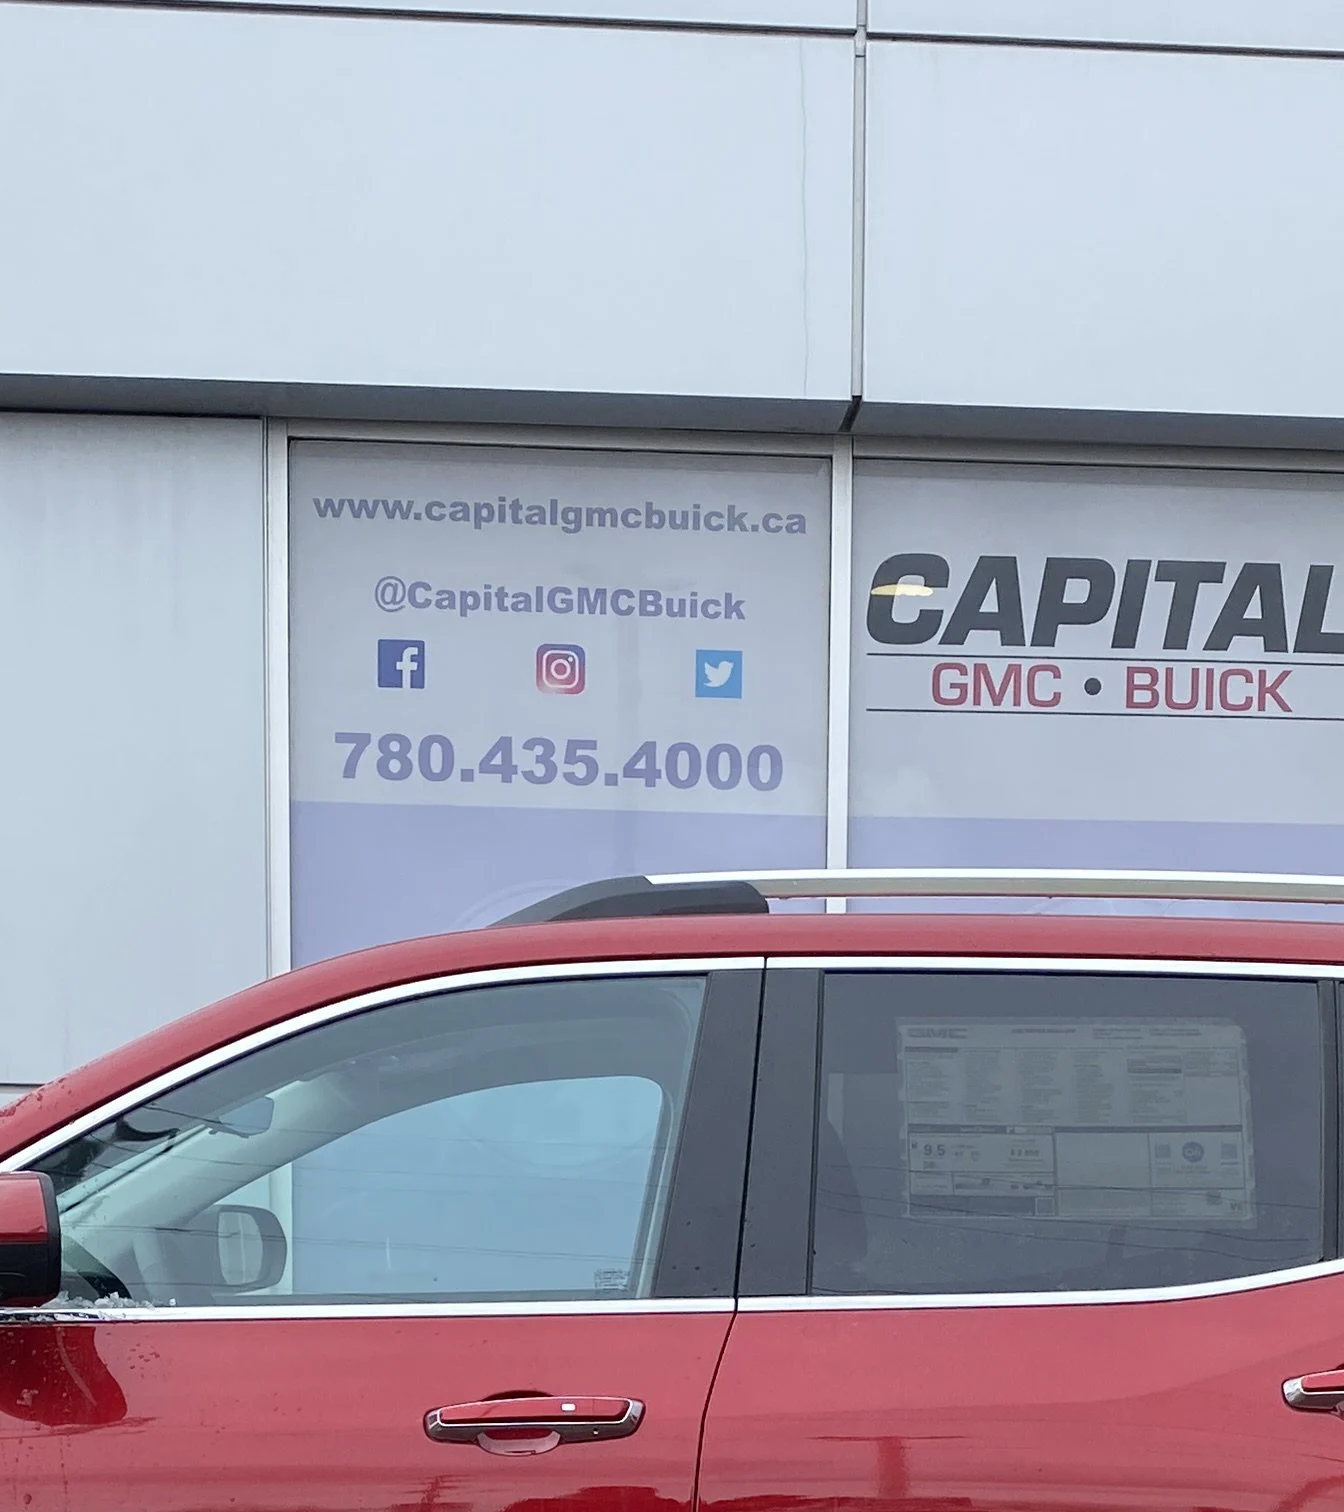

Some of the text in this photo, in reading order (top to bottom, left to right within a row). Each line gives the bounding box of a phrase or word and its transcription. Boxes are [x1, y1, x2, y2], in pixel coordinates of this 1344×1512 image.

[312, 495, 807, 535] www.capitalgmcbuick.ca
[374, 575, 746, 621] @CapitalGMCBuick
[931, 662, 1294, 713] GMC BUICK
[334, 731, 784, 792] 780.435.4000
